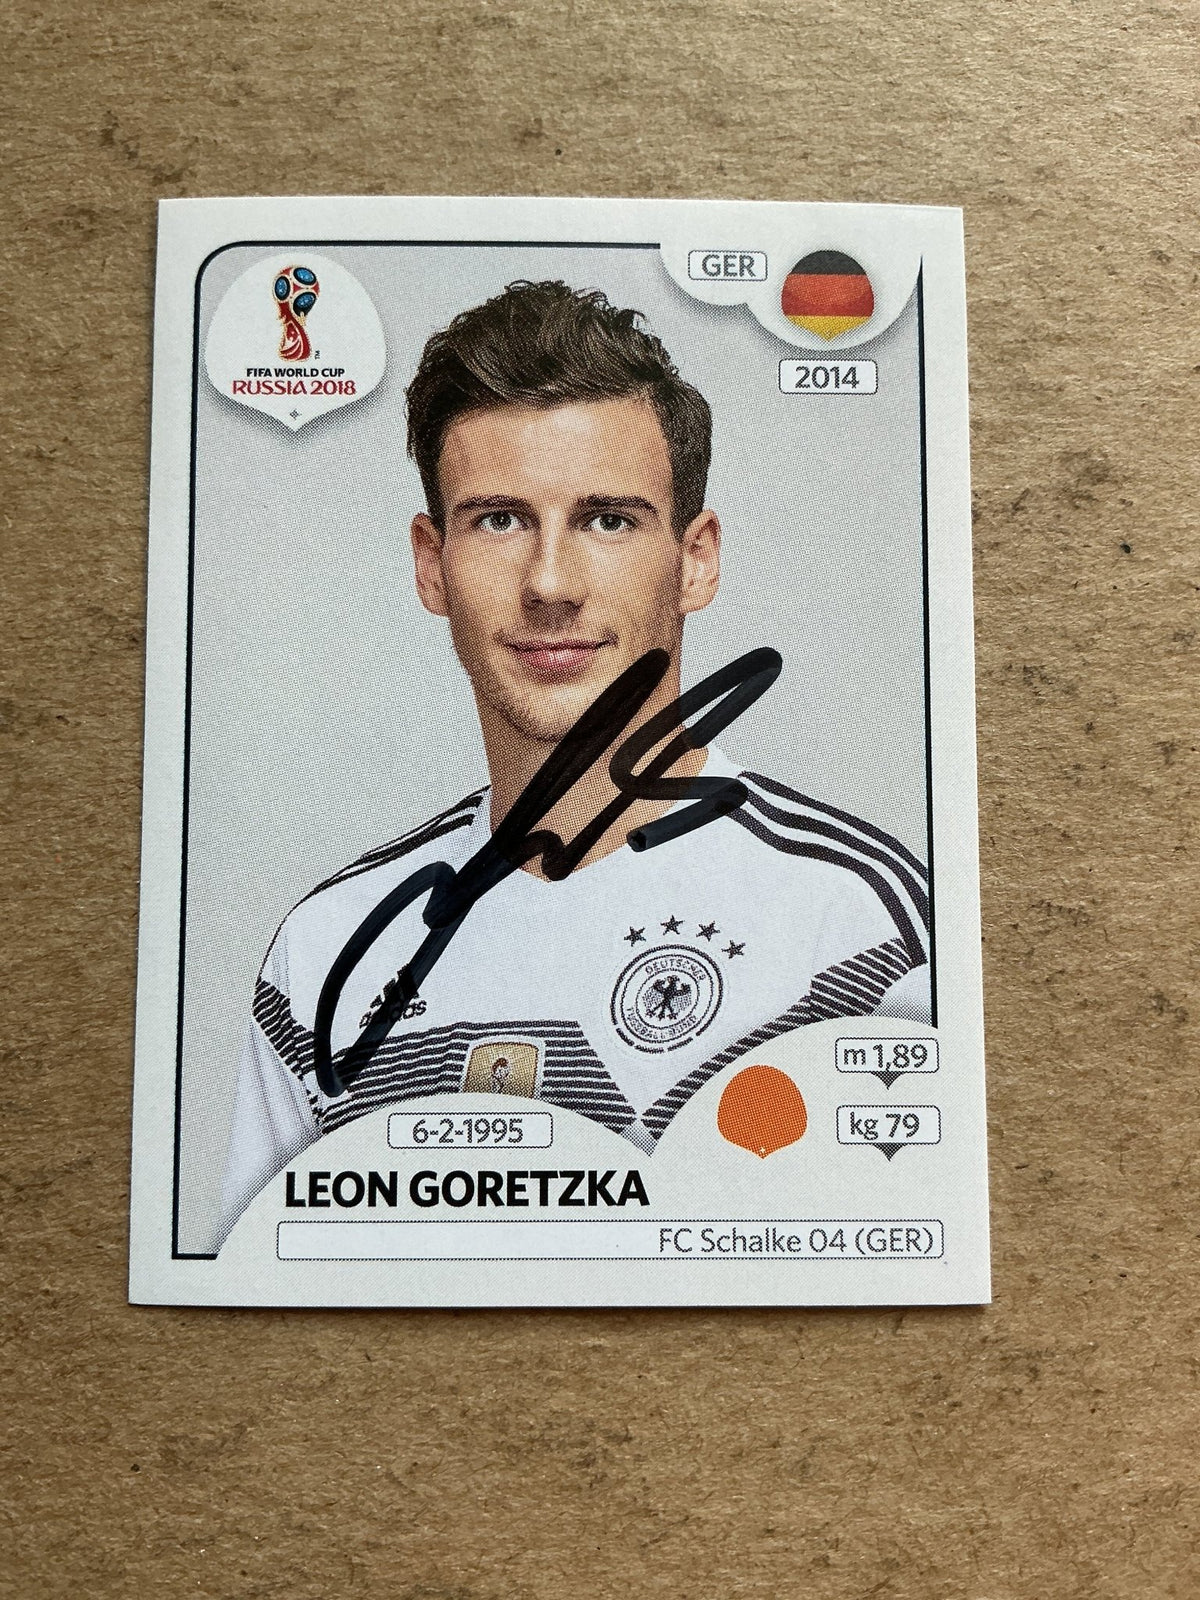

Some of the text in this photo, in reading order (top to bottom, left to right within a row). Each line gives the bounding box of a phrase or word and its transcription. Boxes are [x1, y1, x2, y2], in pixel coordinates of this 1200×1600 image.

[701, 254, 756, 277] GER
[246, 368, 345, 378] FIFA WORLD CUP
[795, 366, 860, 389] 2014
[232, 380, 357, 395] RUSSIA 2018
[843, 1044, 928, 1071] m 1,89
[412, 1118, 524, 1144] 6-2-1995
[850, 1112, 920, 1141] kg 79
[285, 1169, 650, 1208] LEON GORETZKA
[659, 1227, 934, 1255] FC Schalke 04 (GER)
